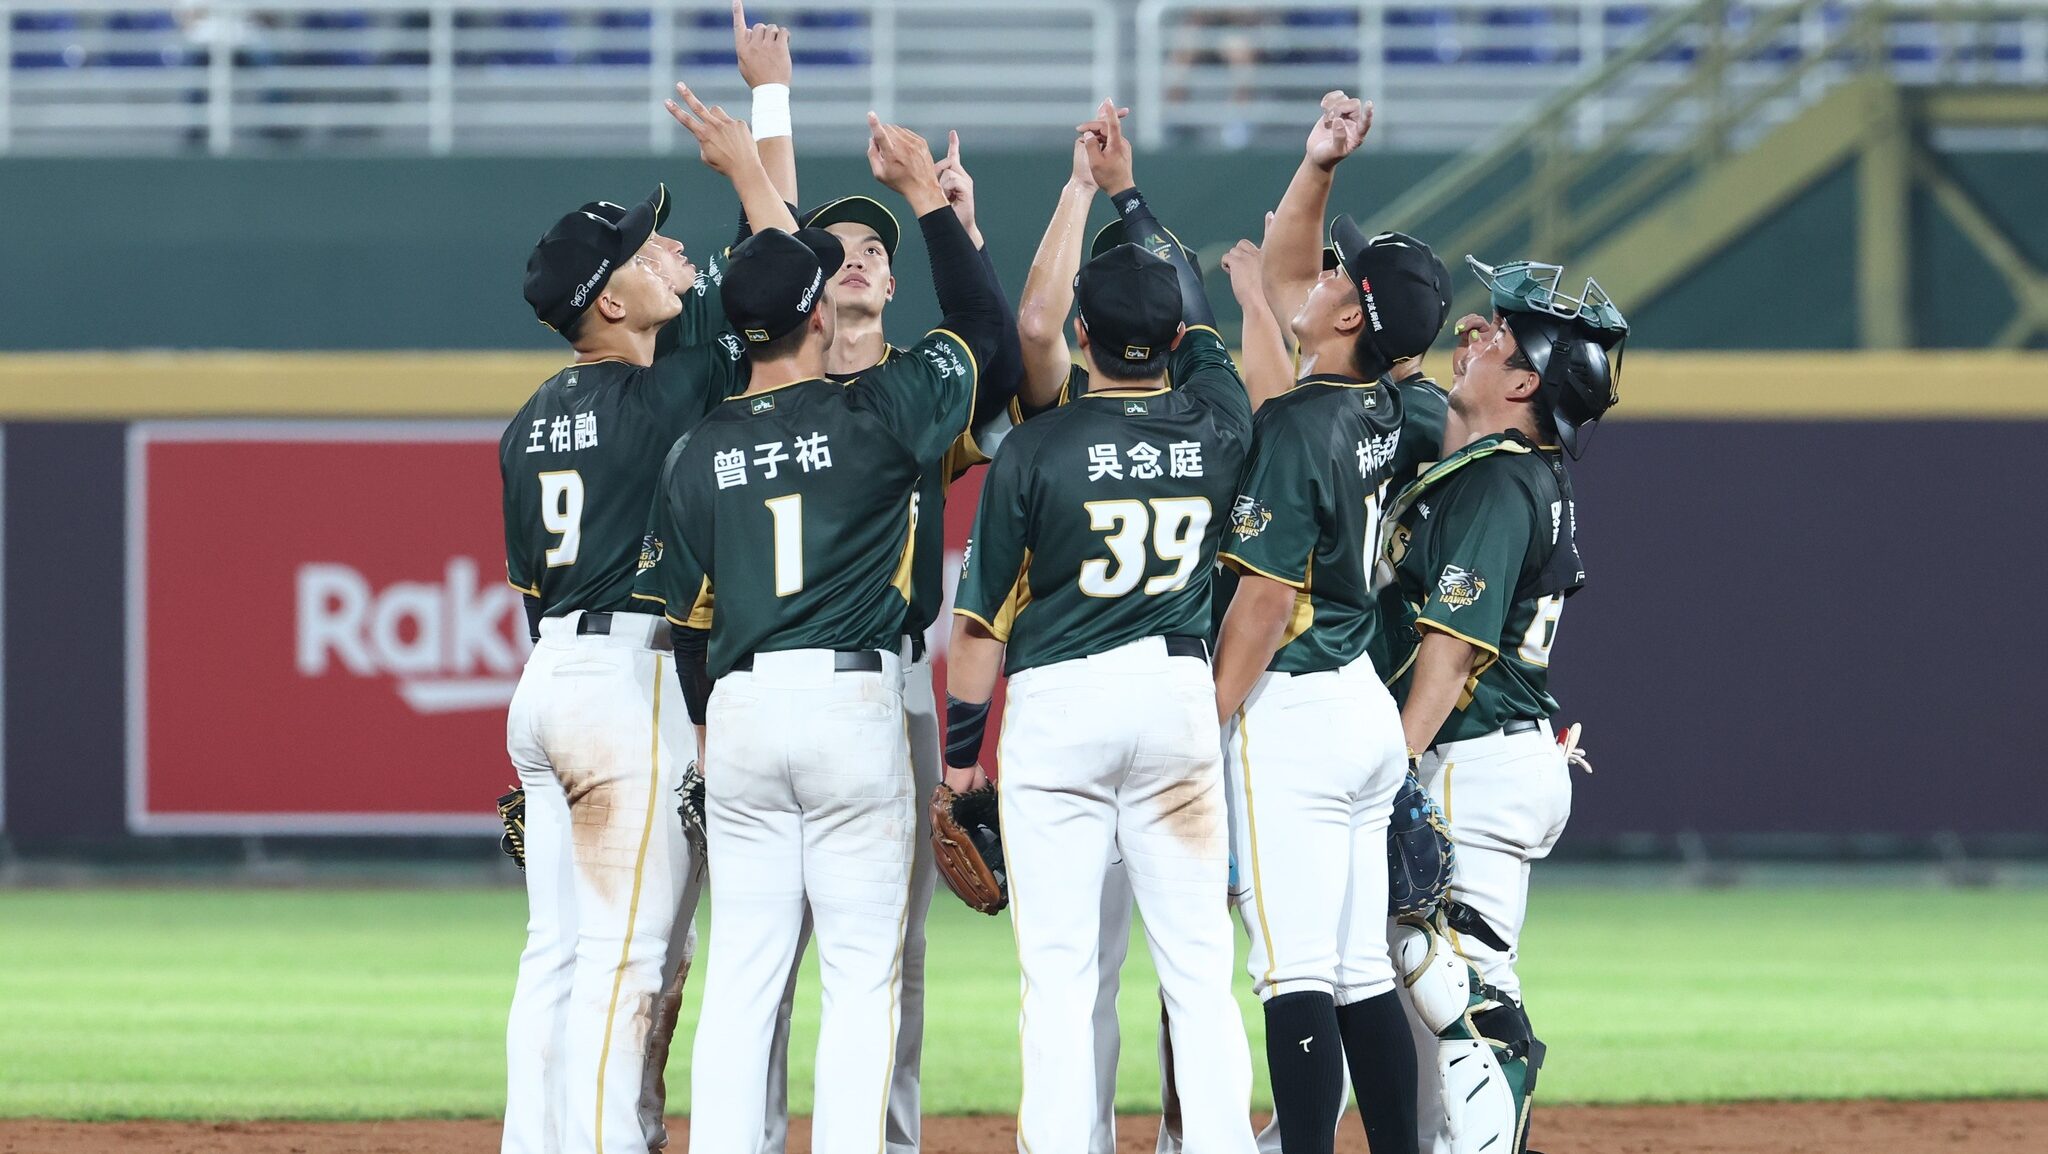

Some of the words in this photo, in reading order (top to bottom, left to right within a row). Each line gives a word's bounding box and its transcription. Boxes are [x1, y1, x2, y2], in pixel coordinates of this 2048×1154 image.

[526, 410, 598, 453] 王柏融
[714, 431, 833, 490] 曾子祐
[1088, 440, 1203, 482] 吳念庭
[538, 469, 584, 568] 9
[765, 493, 803, 597] 1
[1079, 496, 1212, 598] 39
[296, 555, 536, 678] Rak
[1439, 594, 1474, 606] HAWKS
[1450, 584, 1467, 597] TSG
